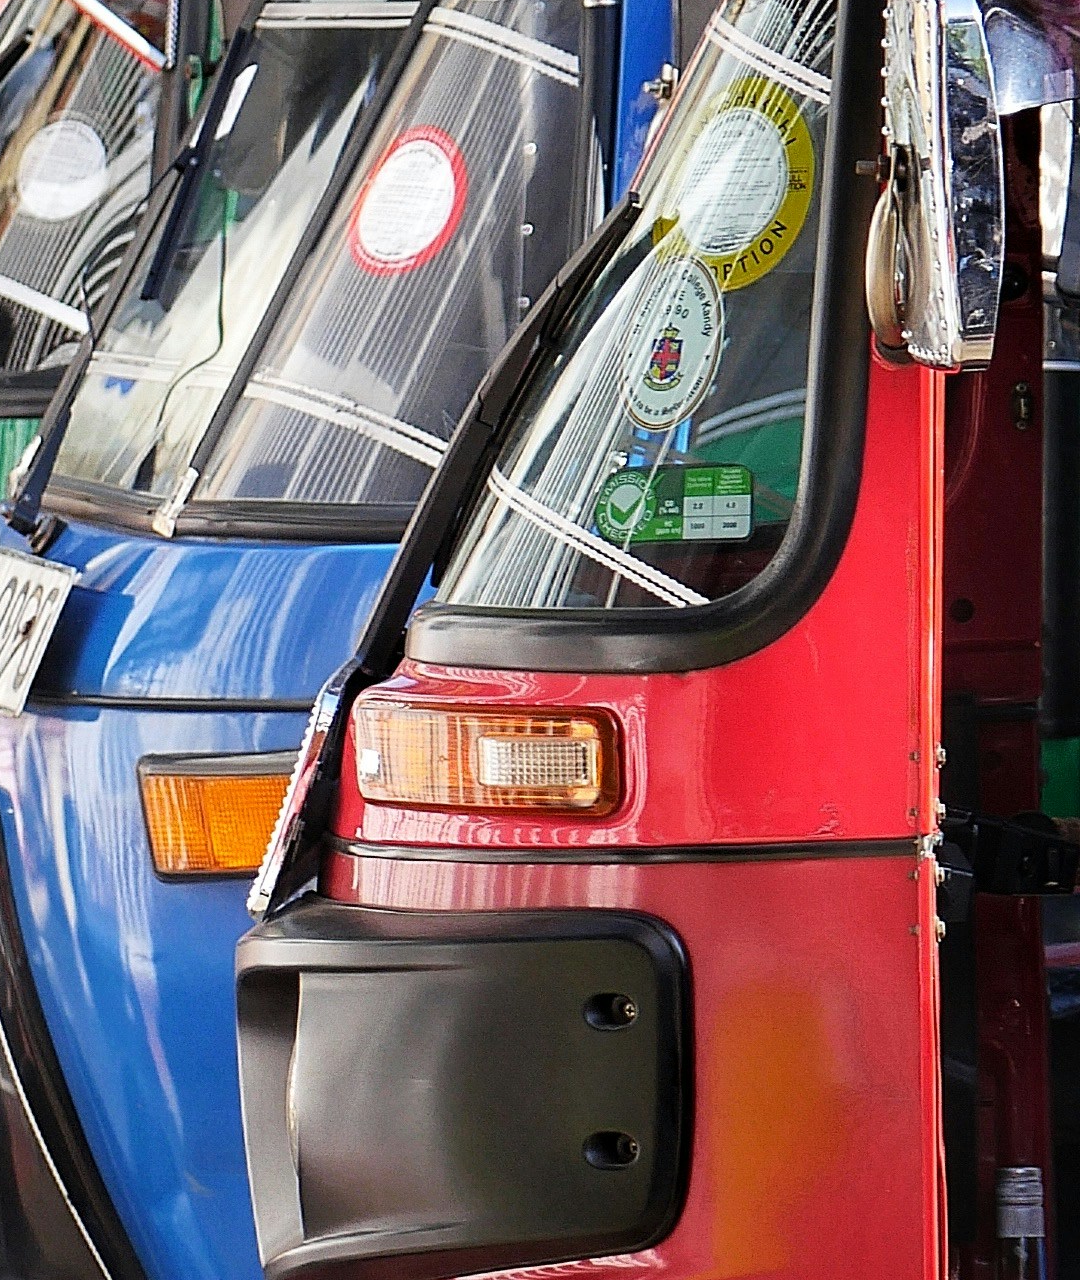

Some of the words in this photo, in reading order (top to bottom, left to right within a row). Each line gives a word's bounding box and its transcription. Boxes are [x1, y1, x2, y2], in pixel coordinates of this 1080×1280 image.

[681, 270, 707, 301] College
[701, 300, 714, 337] Kandy
[599, 471, 655, 505] EMISSION
[598, 510, 654, 539] CHECKED
